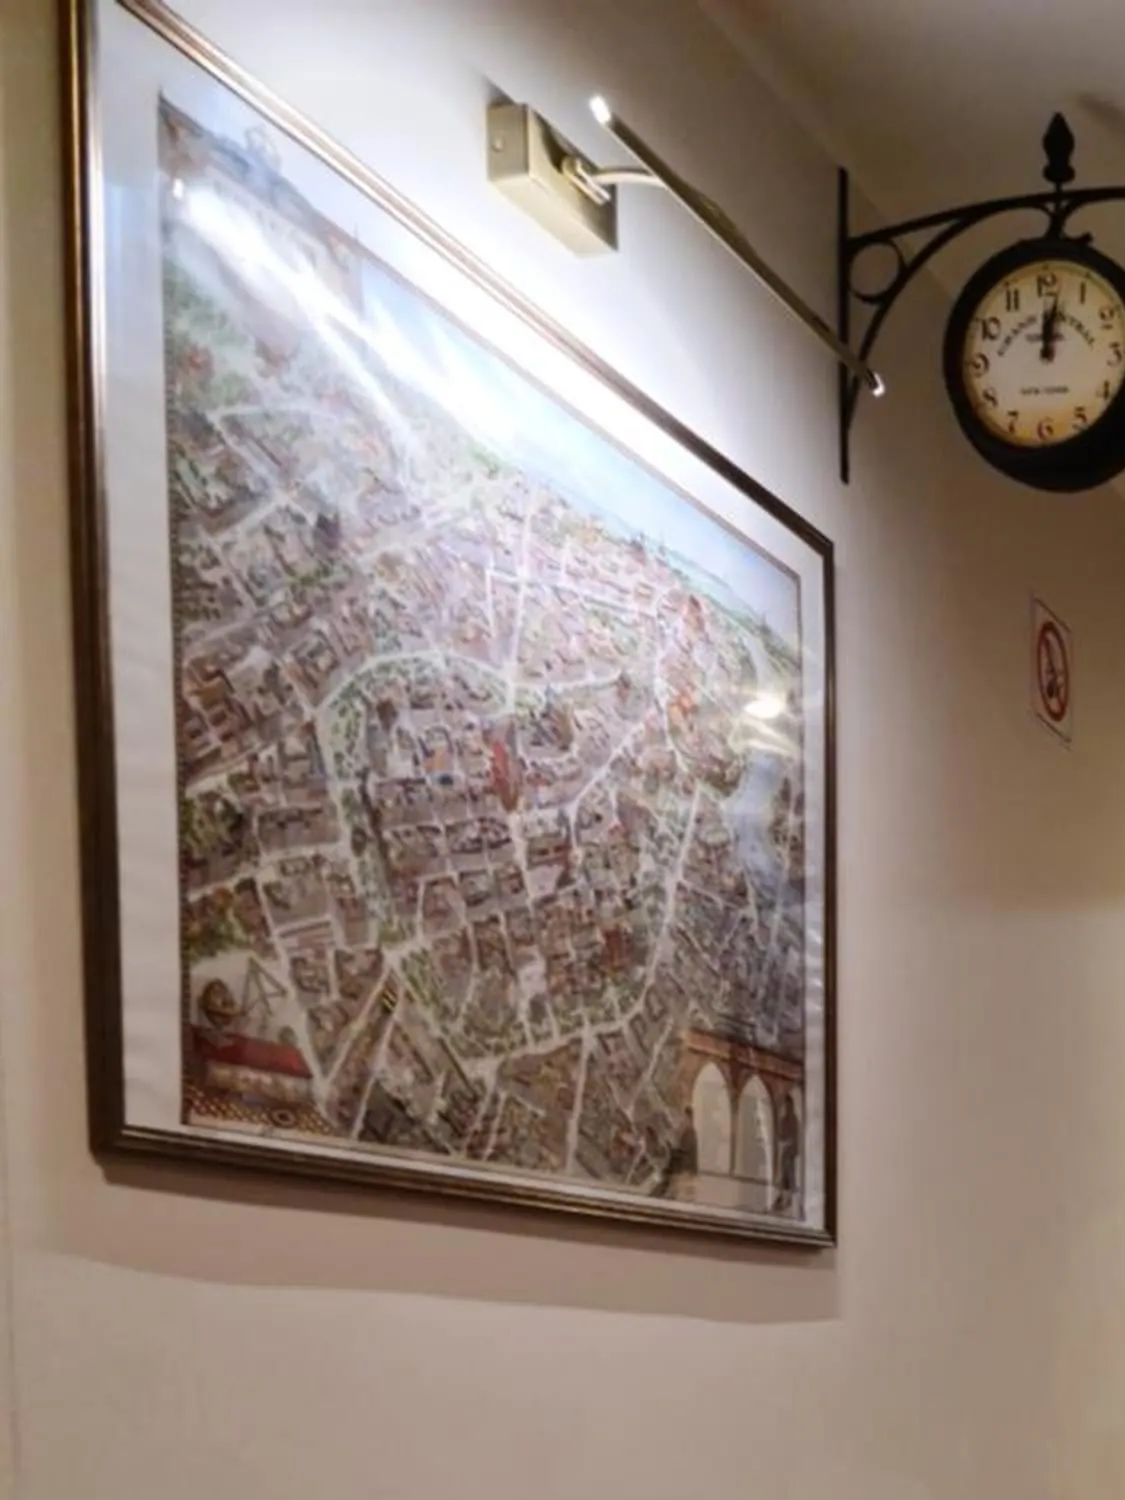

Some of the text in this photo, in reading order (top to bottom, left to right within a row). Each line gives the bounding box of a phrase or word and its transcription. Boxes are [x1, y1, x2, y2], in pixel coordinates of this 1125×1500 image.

[1036, 271, 1057, 298] 12
[1079, 280, 1088, 305] 1
[1005, 287, 1020, 312] 11
[981, 315, 1001, 341] 10
[1098, 305, 1115, 330] 2
[971, 353, 990, 377] 9
[1106, 341, 1123, 366] 3
[981, 386, 999, 408] 8
[1095, 380, 1110, 401] 4
[1006, 409, 1020, 435] 7
[1036, 416, 1055, 441] 6
[1071, 405, 1088, 431] 5
